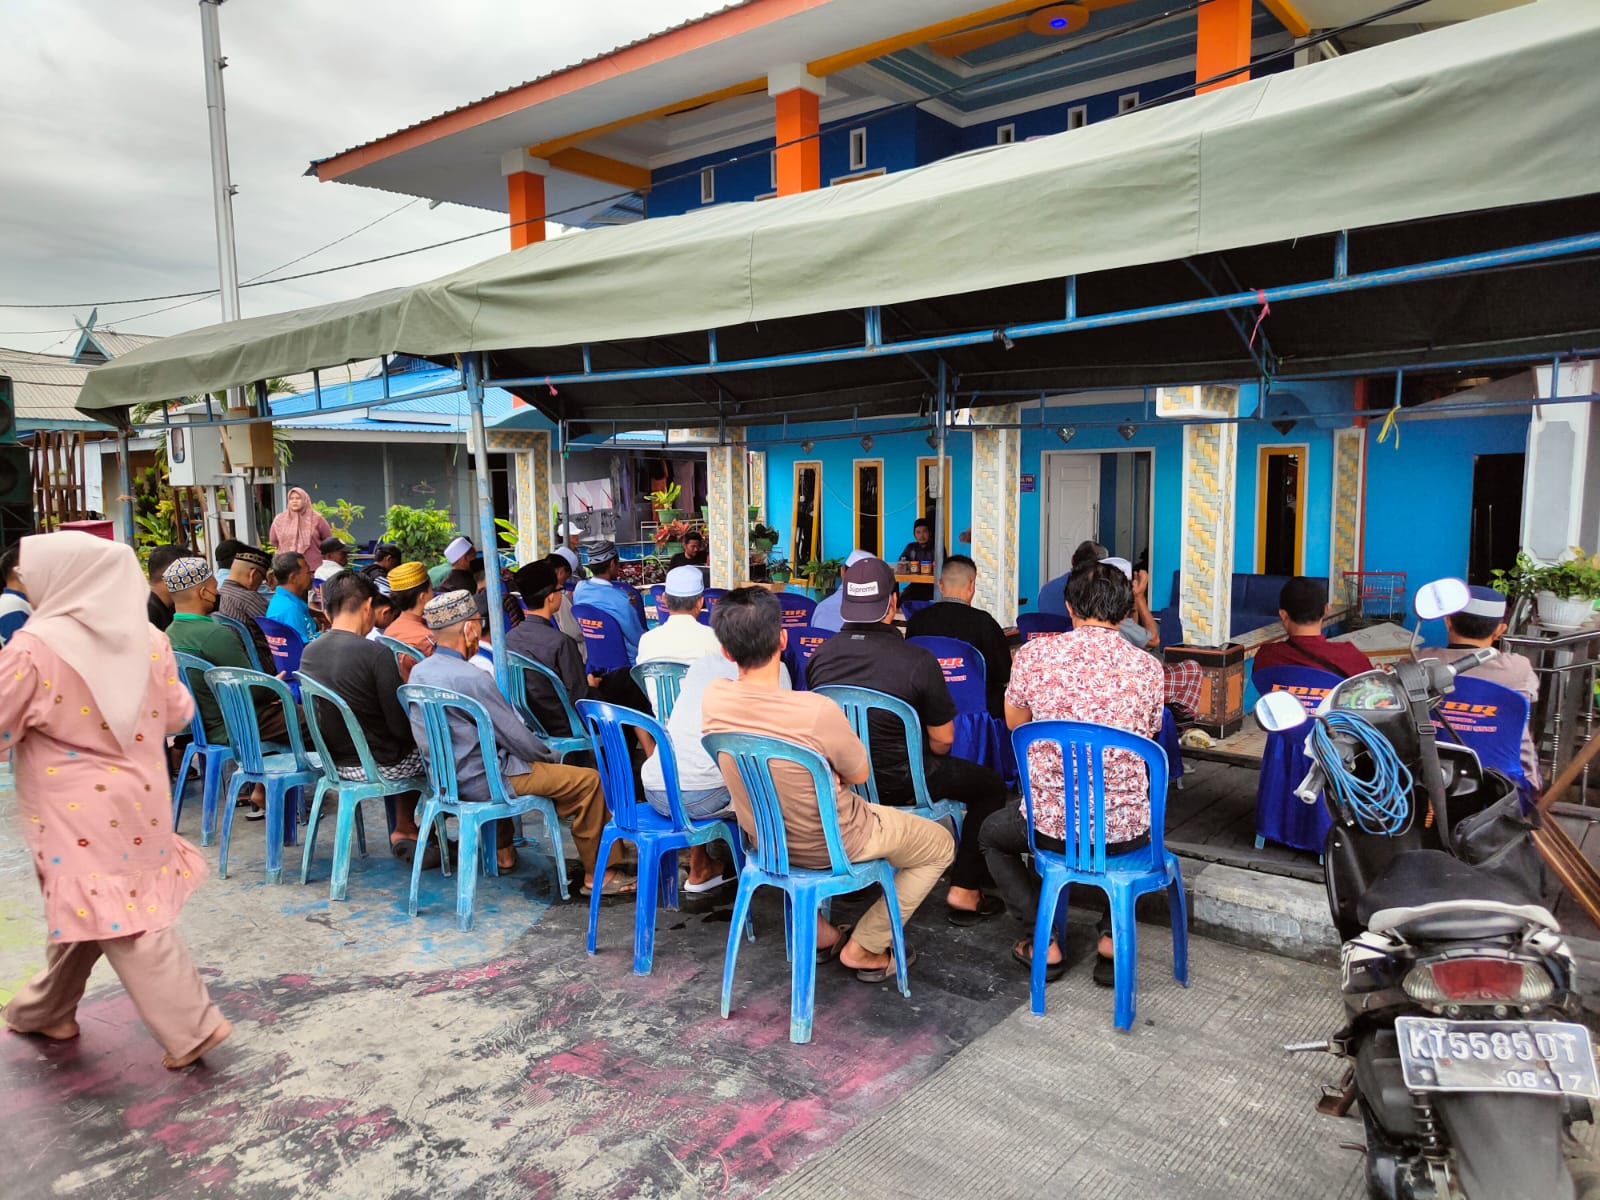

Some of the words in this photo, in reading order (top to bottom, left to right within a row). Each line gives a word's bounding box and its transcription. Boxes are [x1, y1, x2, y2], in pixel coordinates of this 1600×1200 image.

[849, 584, 877, 594] Supreme
[800, 636, 828, 645] FB
[1440, 700, 1498, 717] BR
